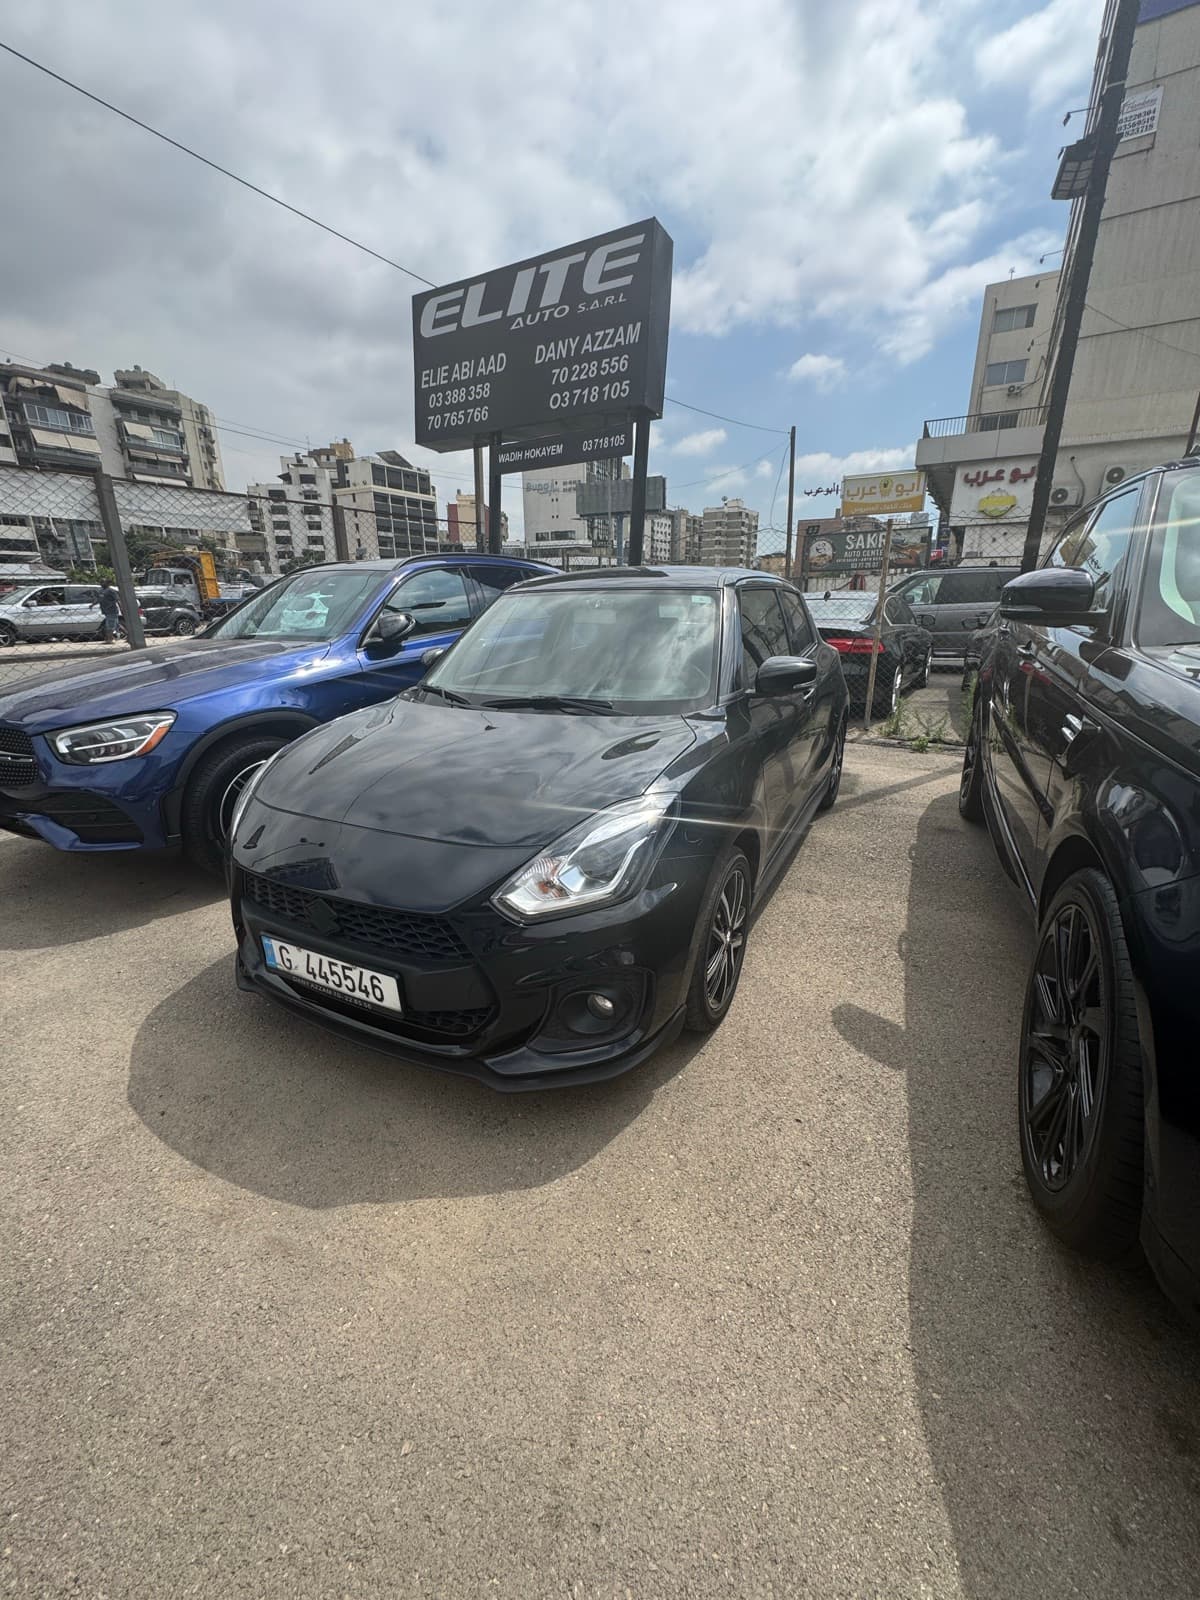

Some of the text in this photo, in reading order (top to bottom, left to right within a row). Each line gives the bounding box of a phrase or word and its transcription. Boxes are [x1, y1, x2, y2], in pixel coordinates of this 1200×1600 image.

[420, 233, 646, 338] ELITE
[510, 292, 627, 330] AUTO S.A.R.L
[534, 321, 642, 365] DANY AZZAM
[421, 352, 507, 388] ELIE ABI AAD
[551, 354, 629, 385] 70 228 556
[428, 382, 490, 409] 03 388 358
[572, 385, 600, 406] 718
[602, 379, 630, 400] 105
[427, 405, 489, 430] 70 765 766
[498, 452, 523, 464] WADIH
[524, 443, 564, 461] HOKAYEM
[963, 468, 1006, 487] عرب
[846, 484, 877, 500] عرب
[862, 549, 884, 557] CENTE
[278, 945, 385, 1003] G 445546
